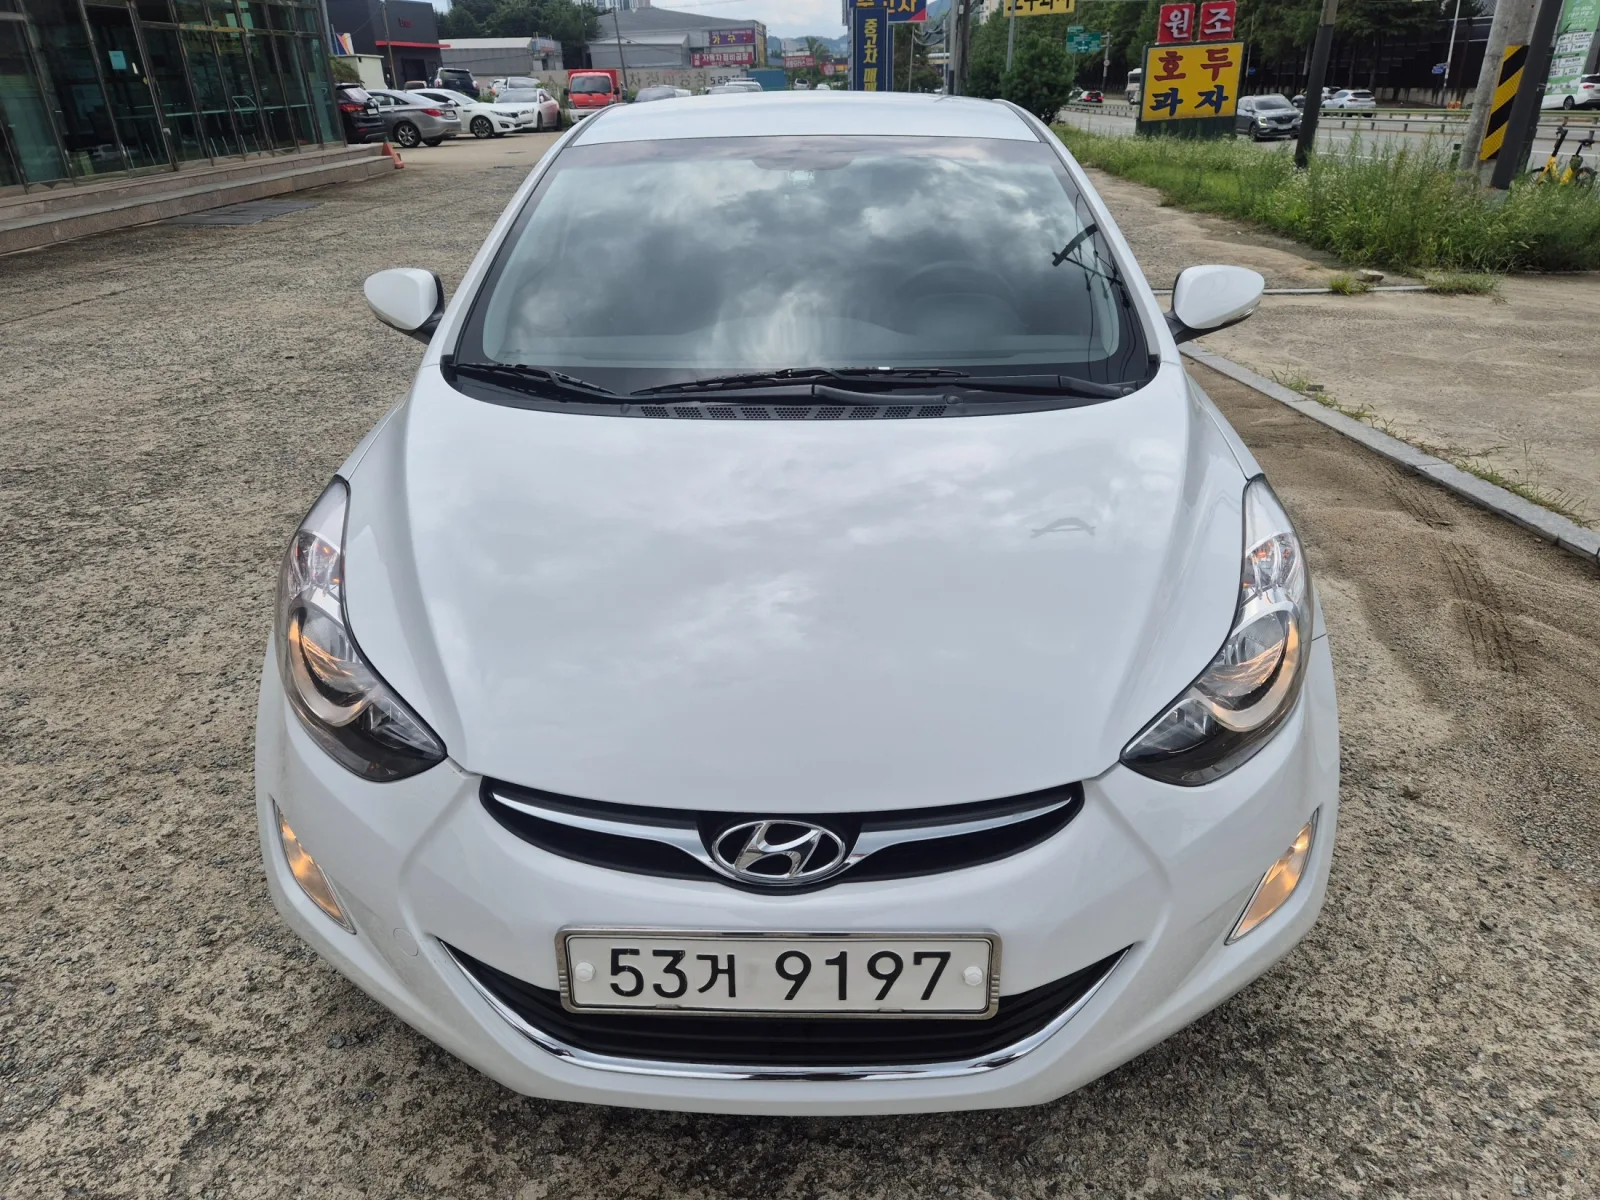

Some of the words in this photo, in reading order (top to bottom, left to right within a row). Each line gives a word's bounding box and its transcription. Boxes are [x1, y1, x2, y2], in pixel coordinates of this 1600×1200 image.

[1165, 8, 1231, 39] 원조
[863, 19, 878, 64] 중고차
[1153, 48, 1233, 82] 호두
[1149, 85, 1229, 117] 과자
[609, 948, 737, 999] 53거
[774, 950, 952, 1001] 9197
